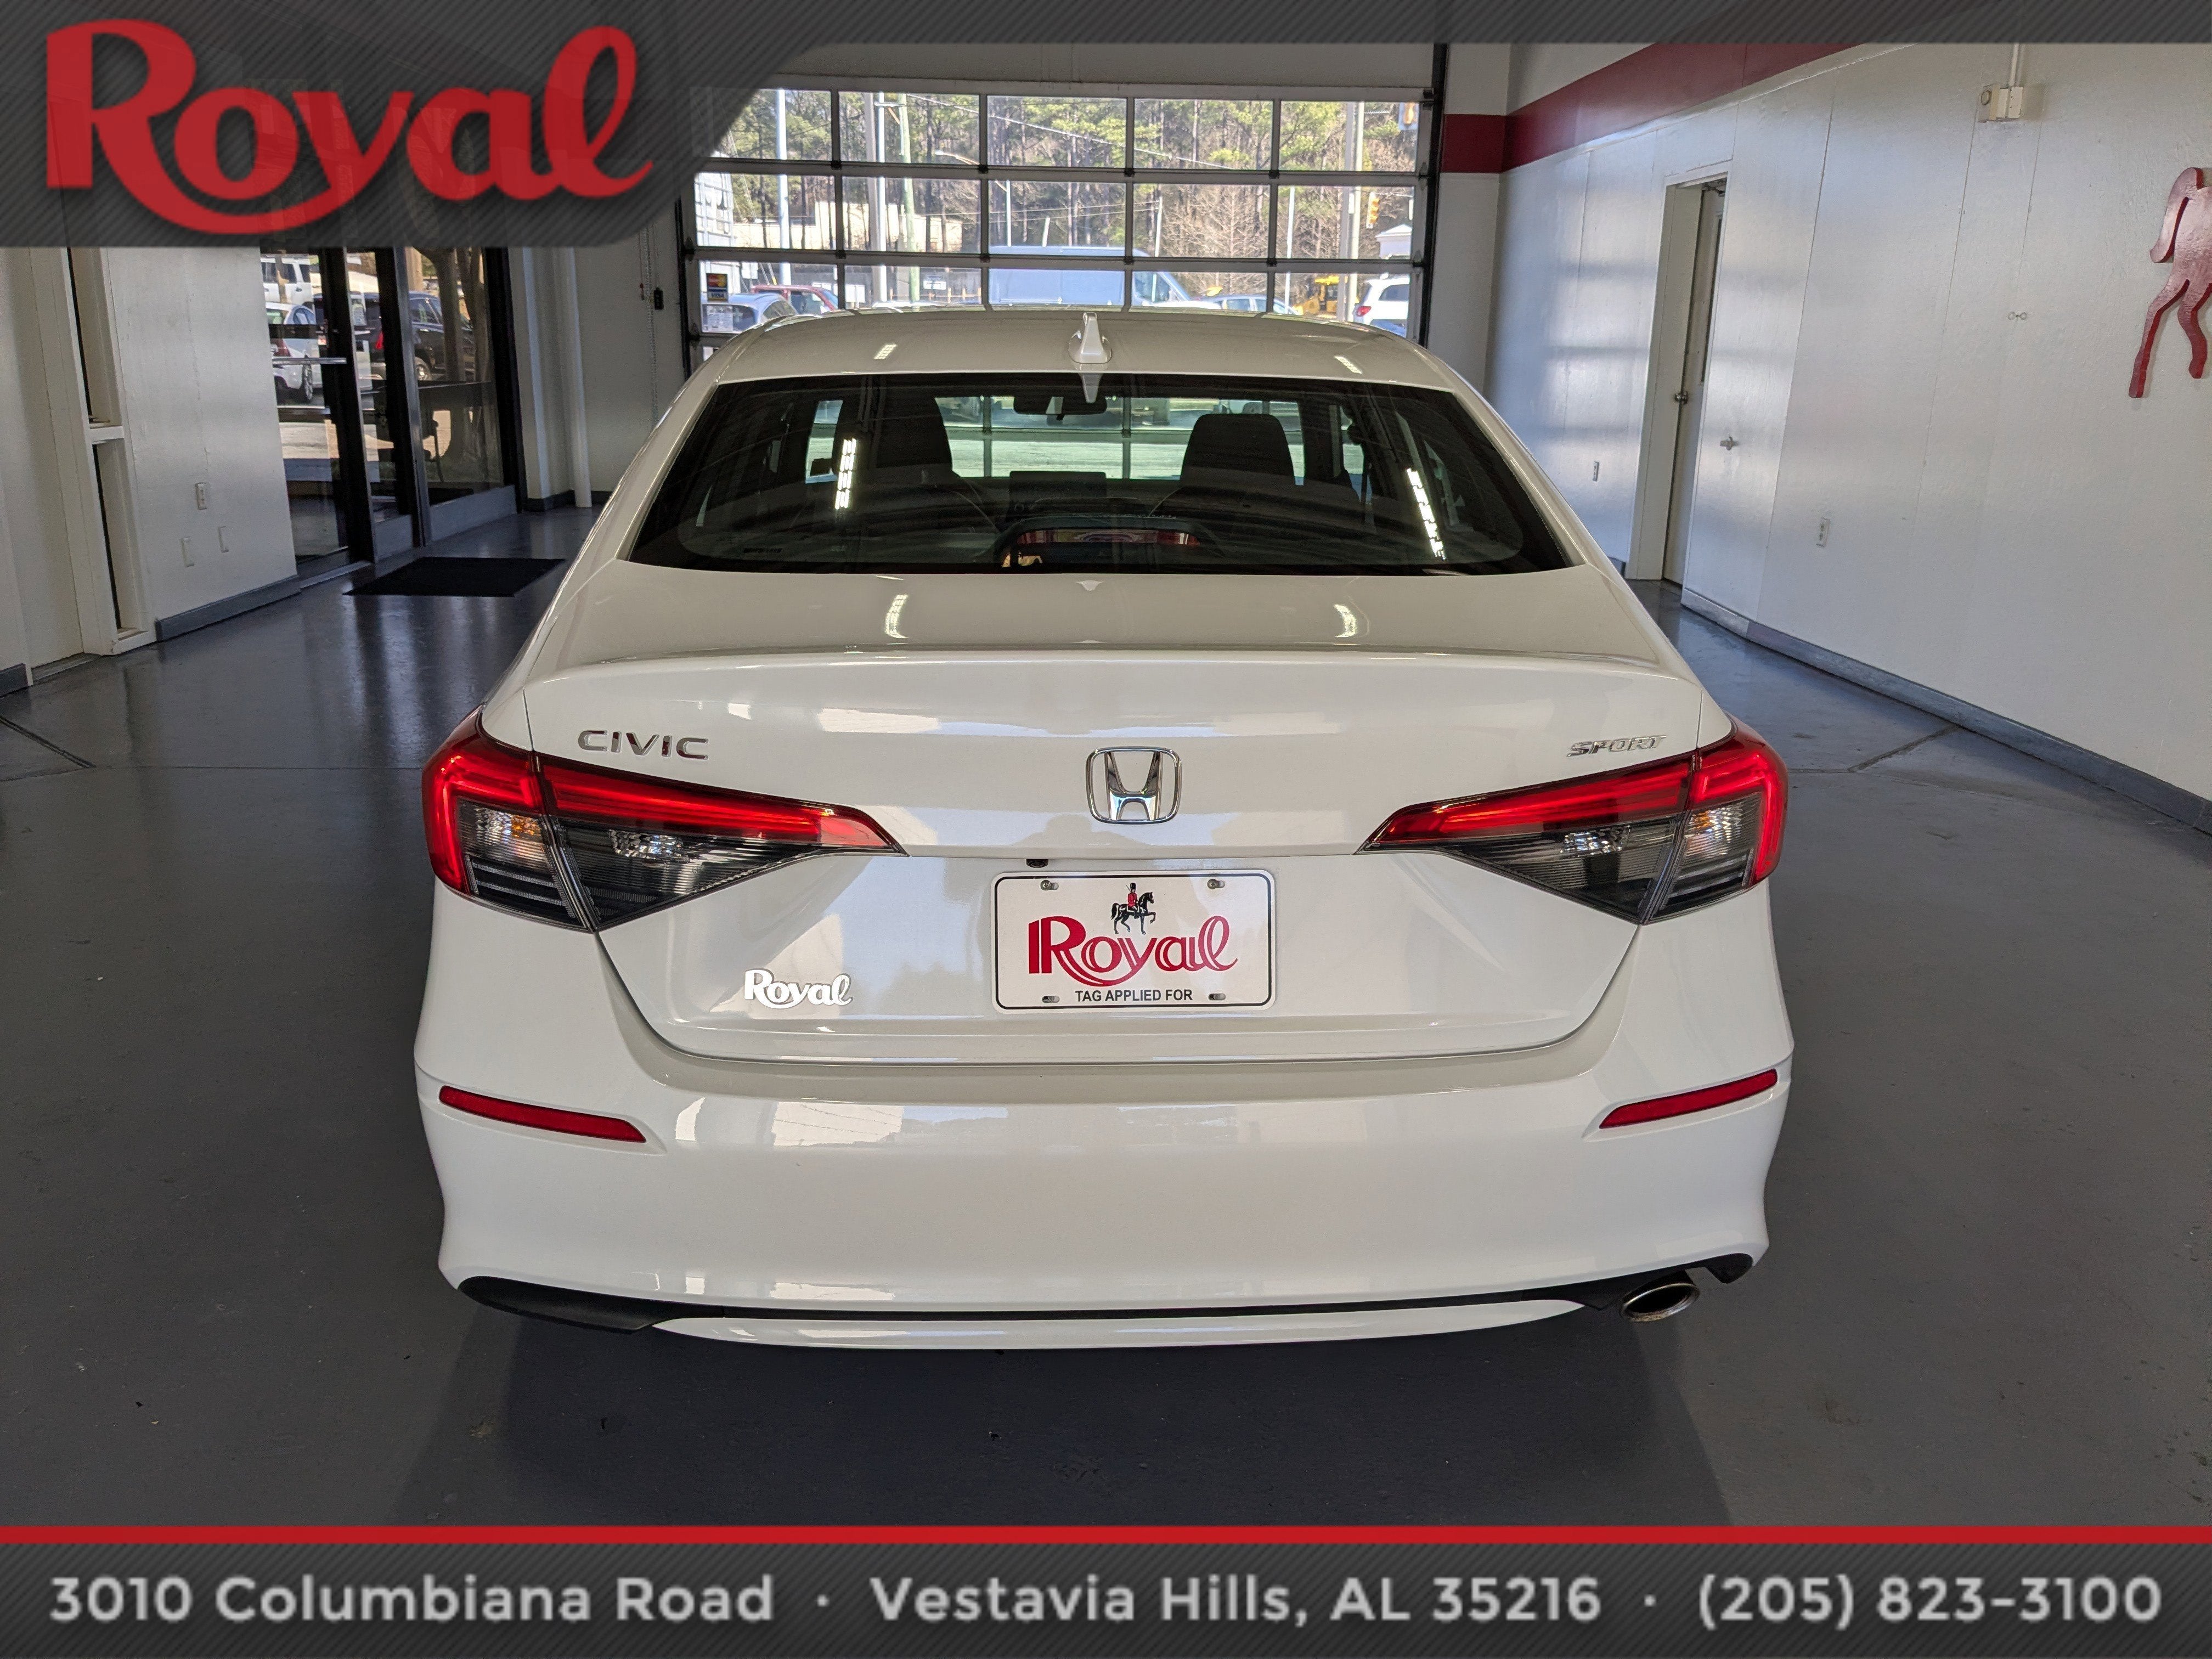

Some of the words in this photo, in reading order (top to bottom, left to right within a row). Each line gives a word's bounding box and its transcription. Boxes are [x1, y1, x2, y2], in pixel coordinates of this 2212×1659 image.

[578, 730, 709, 760] CIVIC
[1567, 735, 1667, 757] SPORT
[1028, 915, 1238, 987] Royal
[744, 968, 854, 1009] Royal
[1075, 990, 1102, 1002] TAG
[1105, 989, 1161, 1002] APPLIED
[1165, 989, 1193, 1001] FOR
